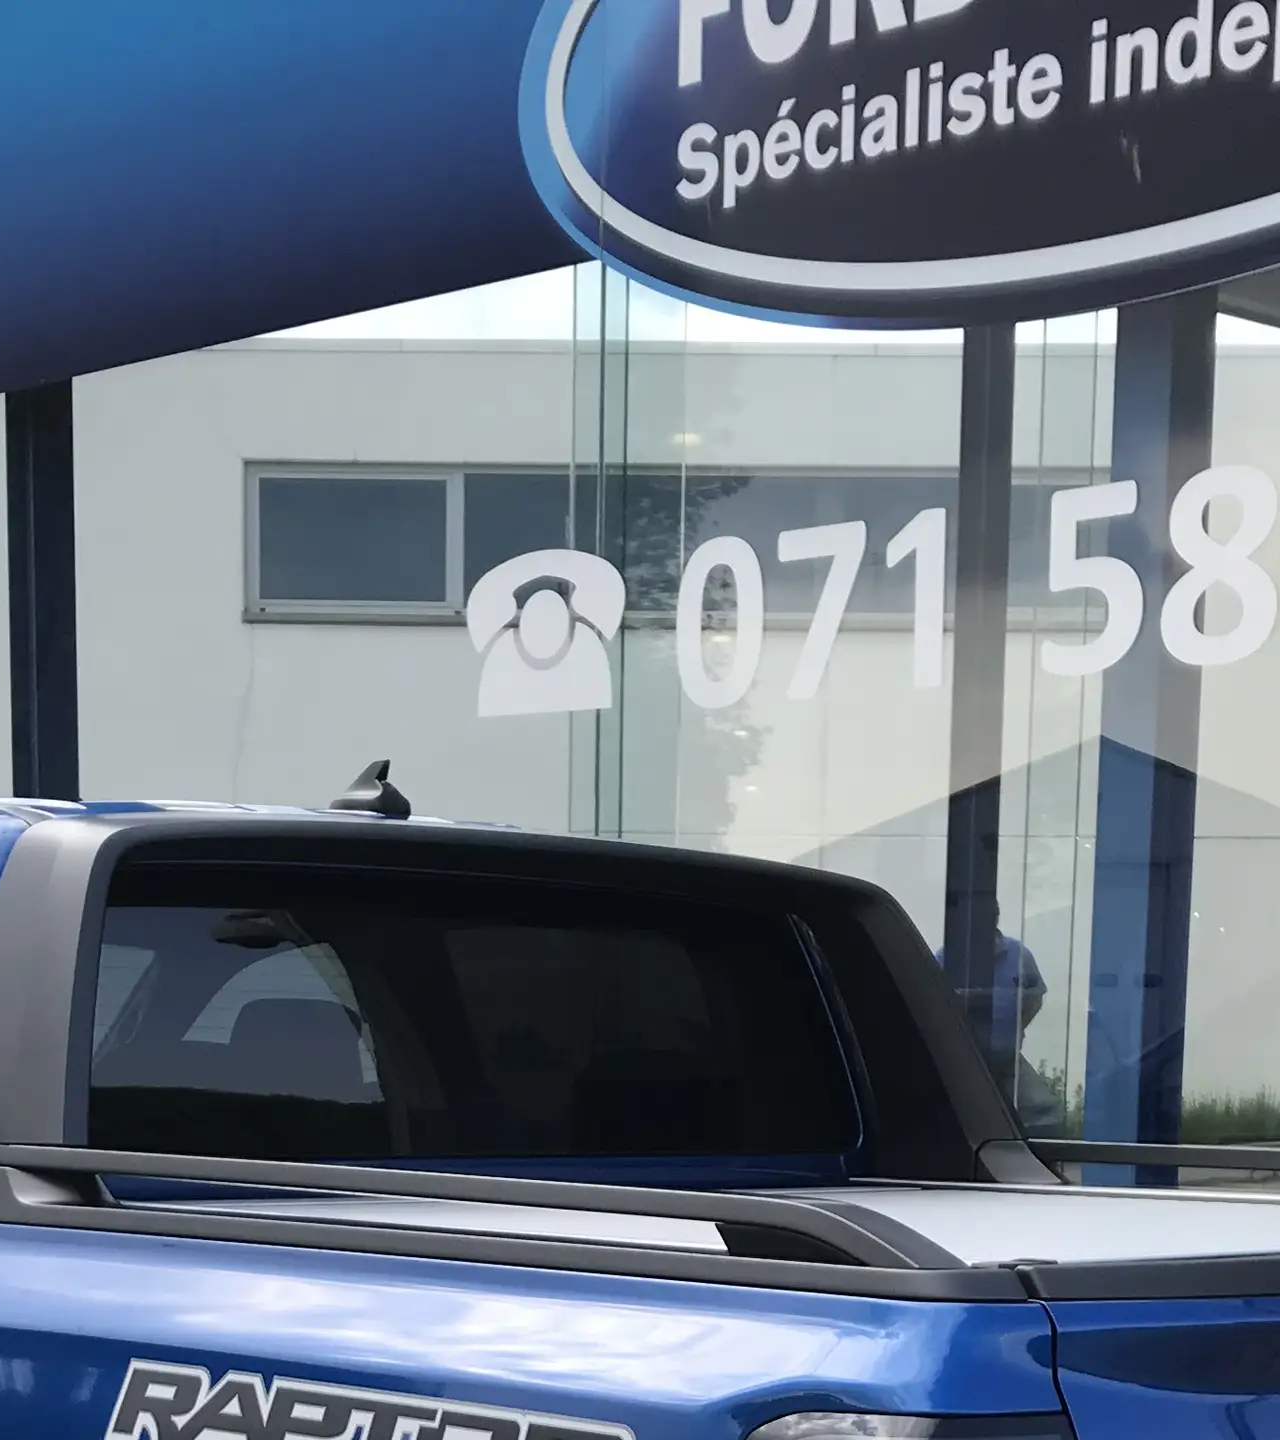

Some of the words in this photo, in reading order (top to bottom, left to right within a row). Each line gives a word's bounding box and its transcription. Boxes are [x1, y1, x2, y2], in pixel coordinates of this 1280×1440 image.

[675, 47, 1064, 209] Spécialiste
[675, 507, 947, 709] 071
[1040, 463, 1279, 677] 58
